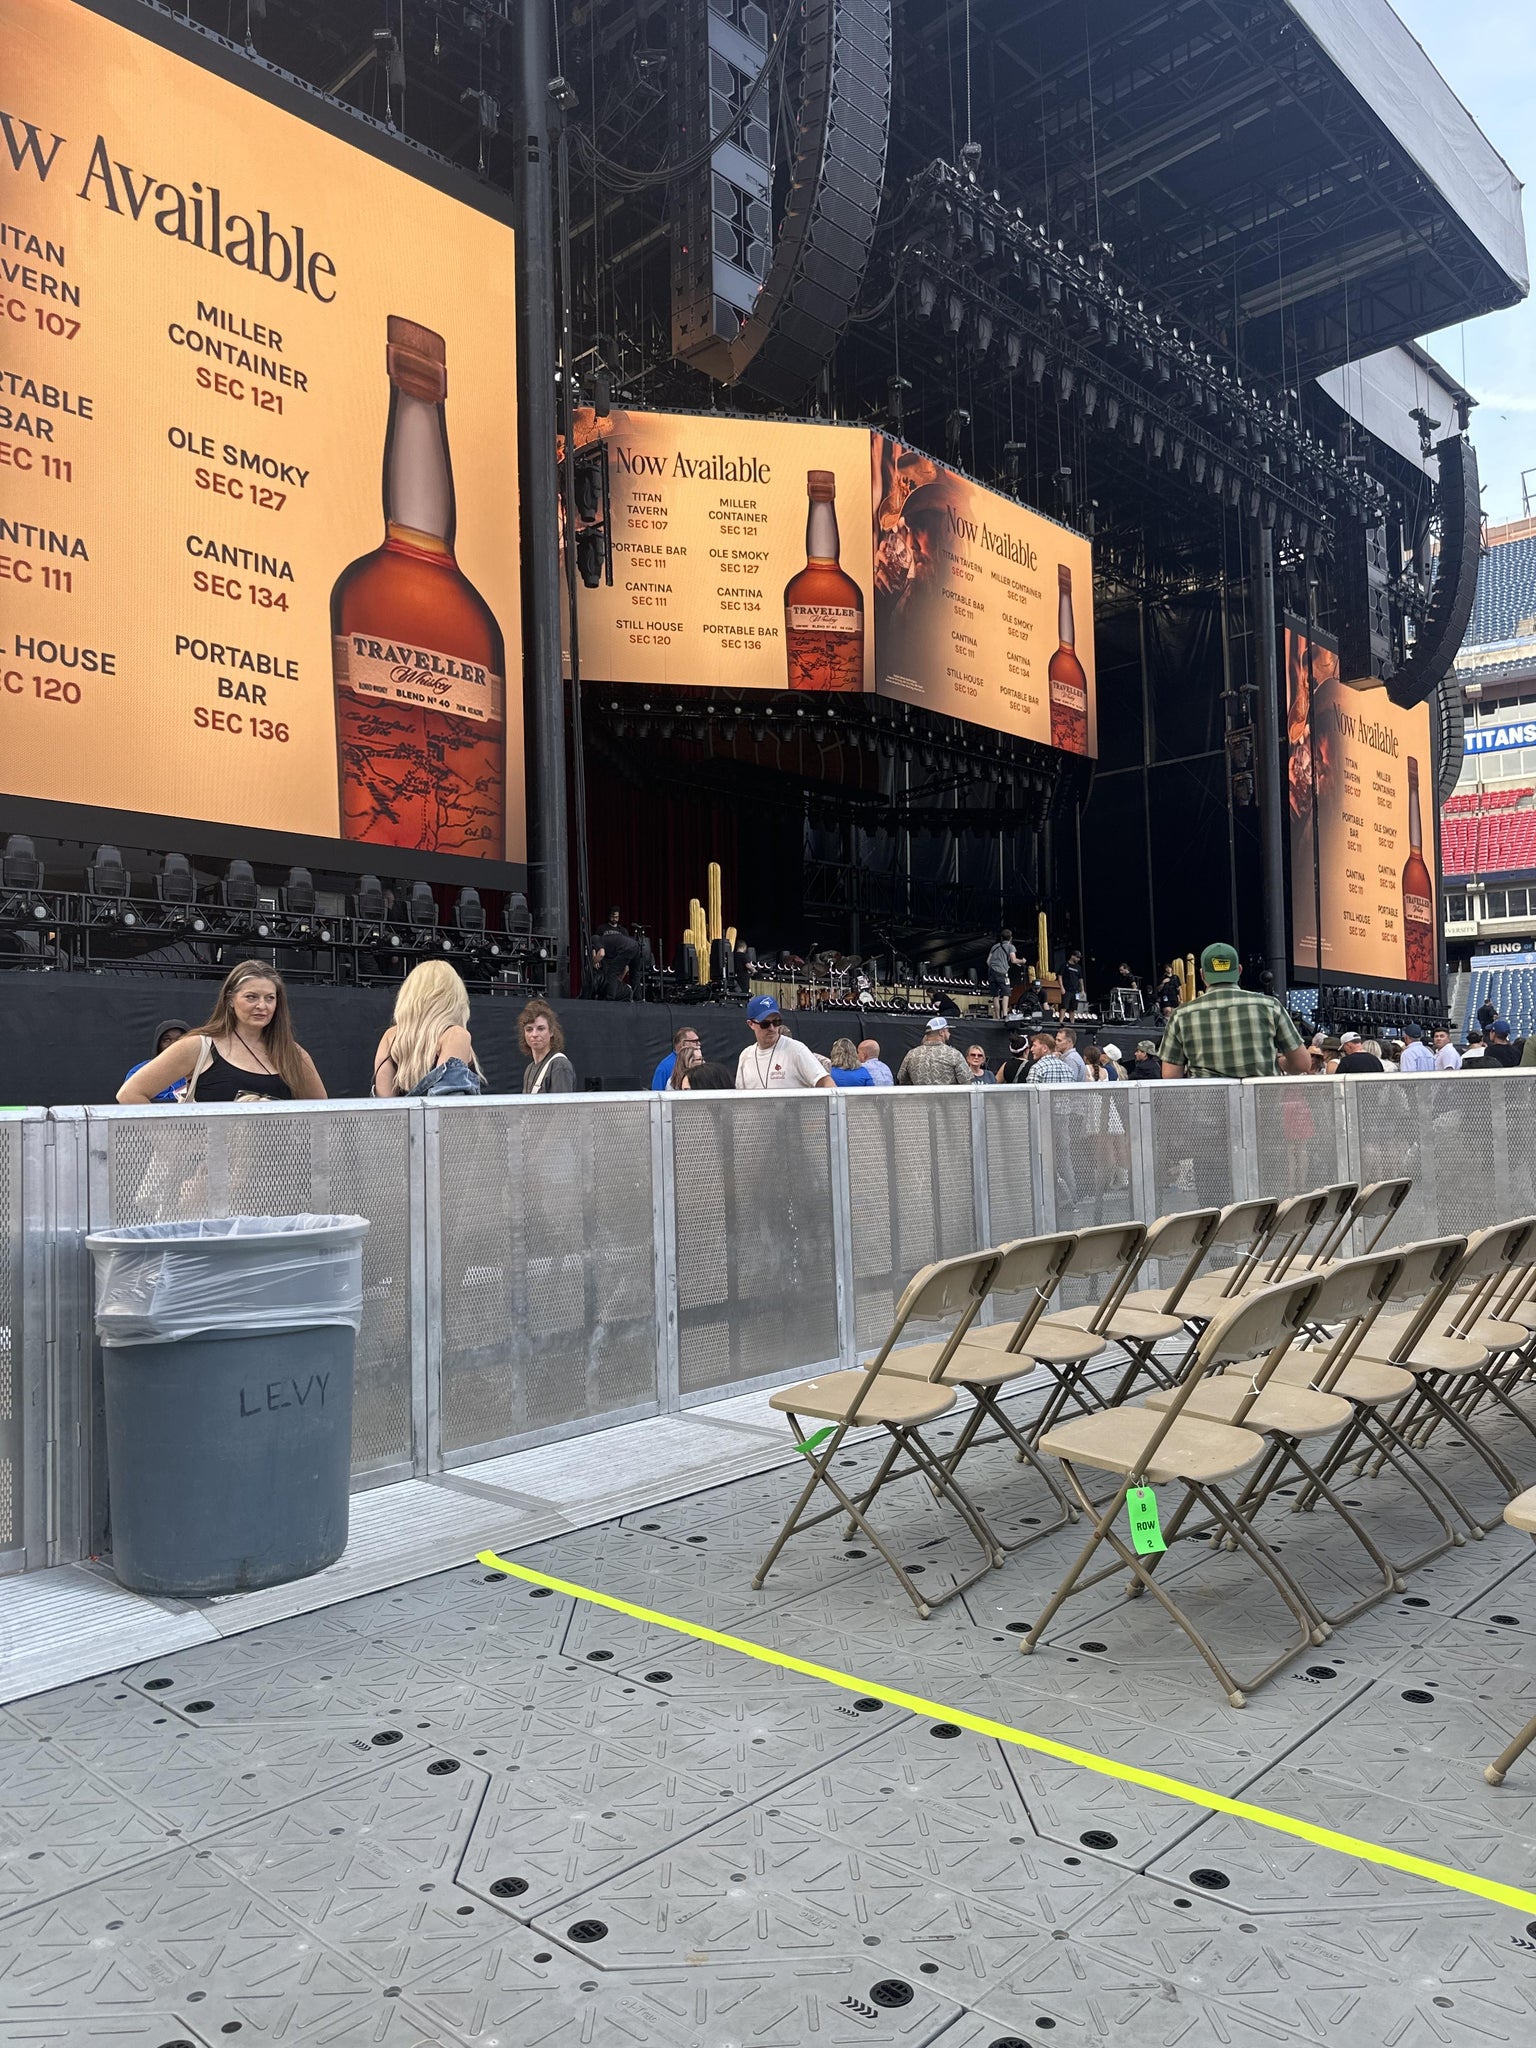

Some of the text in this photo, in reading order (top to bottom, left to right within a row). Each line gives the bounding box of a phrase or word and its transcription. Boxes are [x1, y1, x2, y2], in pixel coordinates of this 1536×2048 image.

[76, 134, 337, 303] Available
[1, 223, 65, 268] ITAN
[0, 257, 80, 307] VERN
[35, 308, 81, 340] 107
[196, 300, 283, 352] MILLER
[168, 323, 309, 393] CONTAINER
[0, 370, 93, 420] TABLE
[196, 366, 283, 415] SEC 121
[0, 405, 54, 443] BAR
[168, 427, 310, 488] OLE SMOKY
[616, 446, 771, 484] Now Available
[41, 454, 72, 483] 111
[195, 467, 287, 512] SEC 127
[632, 492, 662, 503] TITAN
[627, 505, 668, 516] TAVERN
[719, 498, 757, 509] MILLER
[627, 519, 668, 530] SEC 107
[708, 511, 768, 523] CONTAINER
[0, 518, 89, 562] NTINA
[720, 525, 757, 536] SEC 121
[946, 504, 1037, 572] Now Available
[186, 535, 295, 582] CANTINA
[611, 542, 687, 556] PORTABLE BAR
[709, 549, 769, 561] OLE SMOKY
[631, 557, 666, 568] SEC 111
[720, 563, 759, 574] SEC 127
[942, 549, 983, 574] TITAN TAVERN
[41, 566, 72, 593] 111
[951, 566, 974, 582] SEC 107
[193, 570, 289, 613] SEC 134
[625, 582, 673, 593] CANTINA
[717, 587, 763, 598] CANTINA
[990, 571, 1042, 600] MILLER CONTAINER
[631, 596, 667, 606] SEC 111
[942, 588, 985, 613] PORTABLE BAR
[1007, 590, 1019, 602] SEC
[720, 601, 761, 611] SEC 134
[793, 606, 855, 617] TRAVELLER
[954, 606, 967, 618] SEC
[616, 619, 684, 632] STILL HOUSE
[703, 624, 778, 637] PORTABLE BAR
[1002, 612, 1034, 631] OLE SMOKY
[629, 634, 671, 645] SEC 120
[951, 631, 978, 647] CANTINA
[1008, 627, 1019, 638] SEC
[721, 639, 761, 650] SEC 136
[955, 644, 967, 656] SEC
[15, 634, 116, 676] HOUSE
[176, 634, 299, 682] PORTABLE
[353, 637, 487, 687] TRAVELLER
[1006, 651, 1031, 667] CANTINA
[946, 667, 984, 687] STILL HOUSE
[1008, 664, 1020, 675] SEC
[390, 665, 453, 695] Whiskey
[954, 682, 967, 693] SEC
[1053, 681, 1083, 697] TRAVELLER
[32, 675, 81, 705] 120
[217, 676, 267, 706] BAR
[396, 688, 425, 703] BLEND
[439, 698, 450, 708] 40
[1000, 686, 1027, 702] PORTABLE
[1027, 694, 1039, 706] BAR
[1009, 701, 1021, 712] SEC
[194, 706, 289, 743] SEC 136
[1333, 701, 1399, 759] Now Available
[1464, 723, 1536, 750] TITANS
[1490, 942, 1521, 954] RING
[240, 1372, 330, 1418] LEVY
[1141, 1503, 1147, 1512] B
[1136, 1521, 1155, 1531] ROW
[1147, 1540, 1154, 1548] 2
